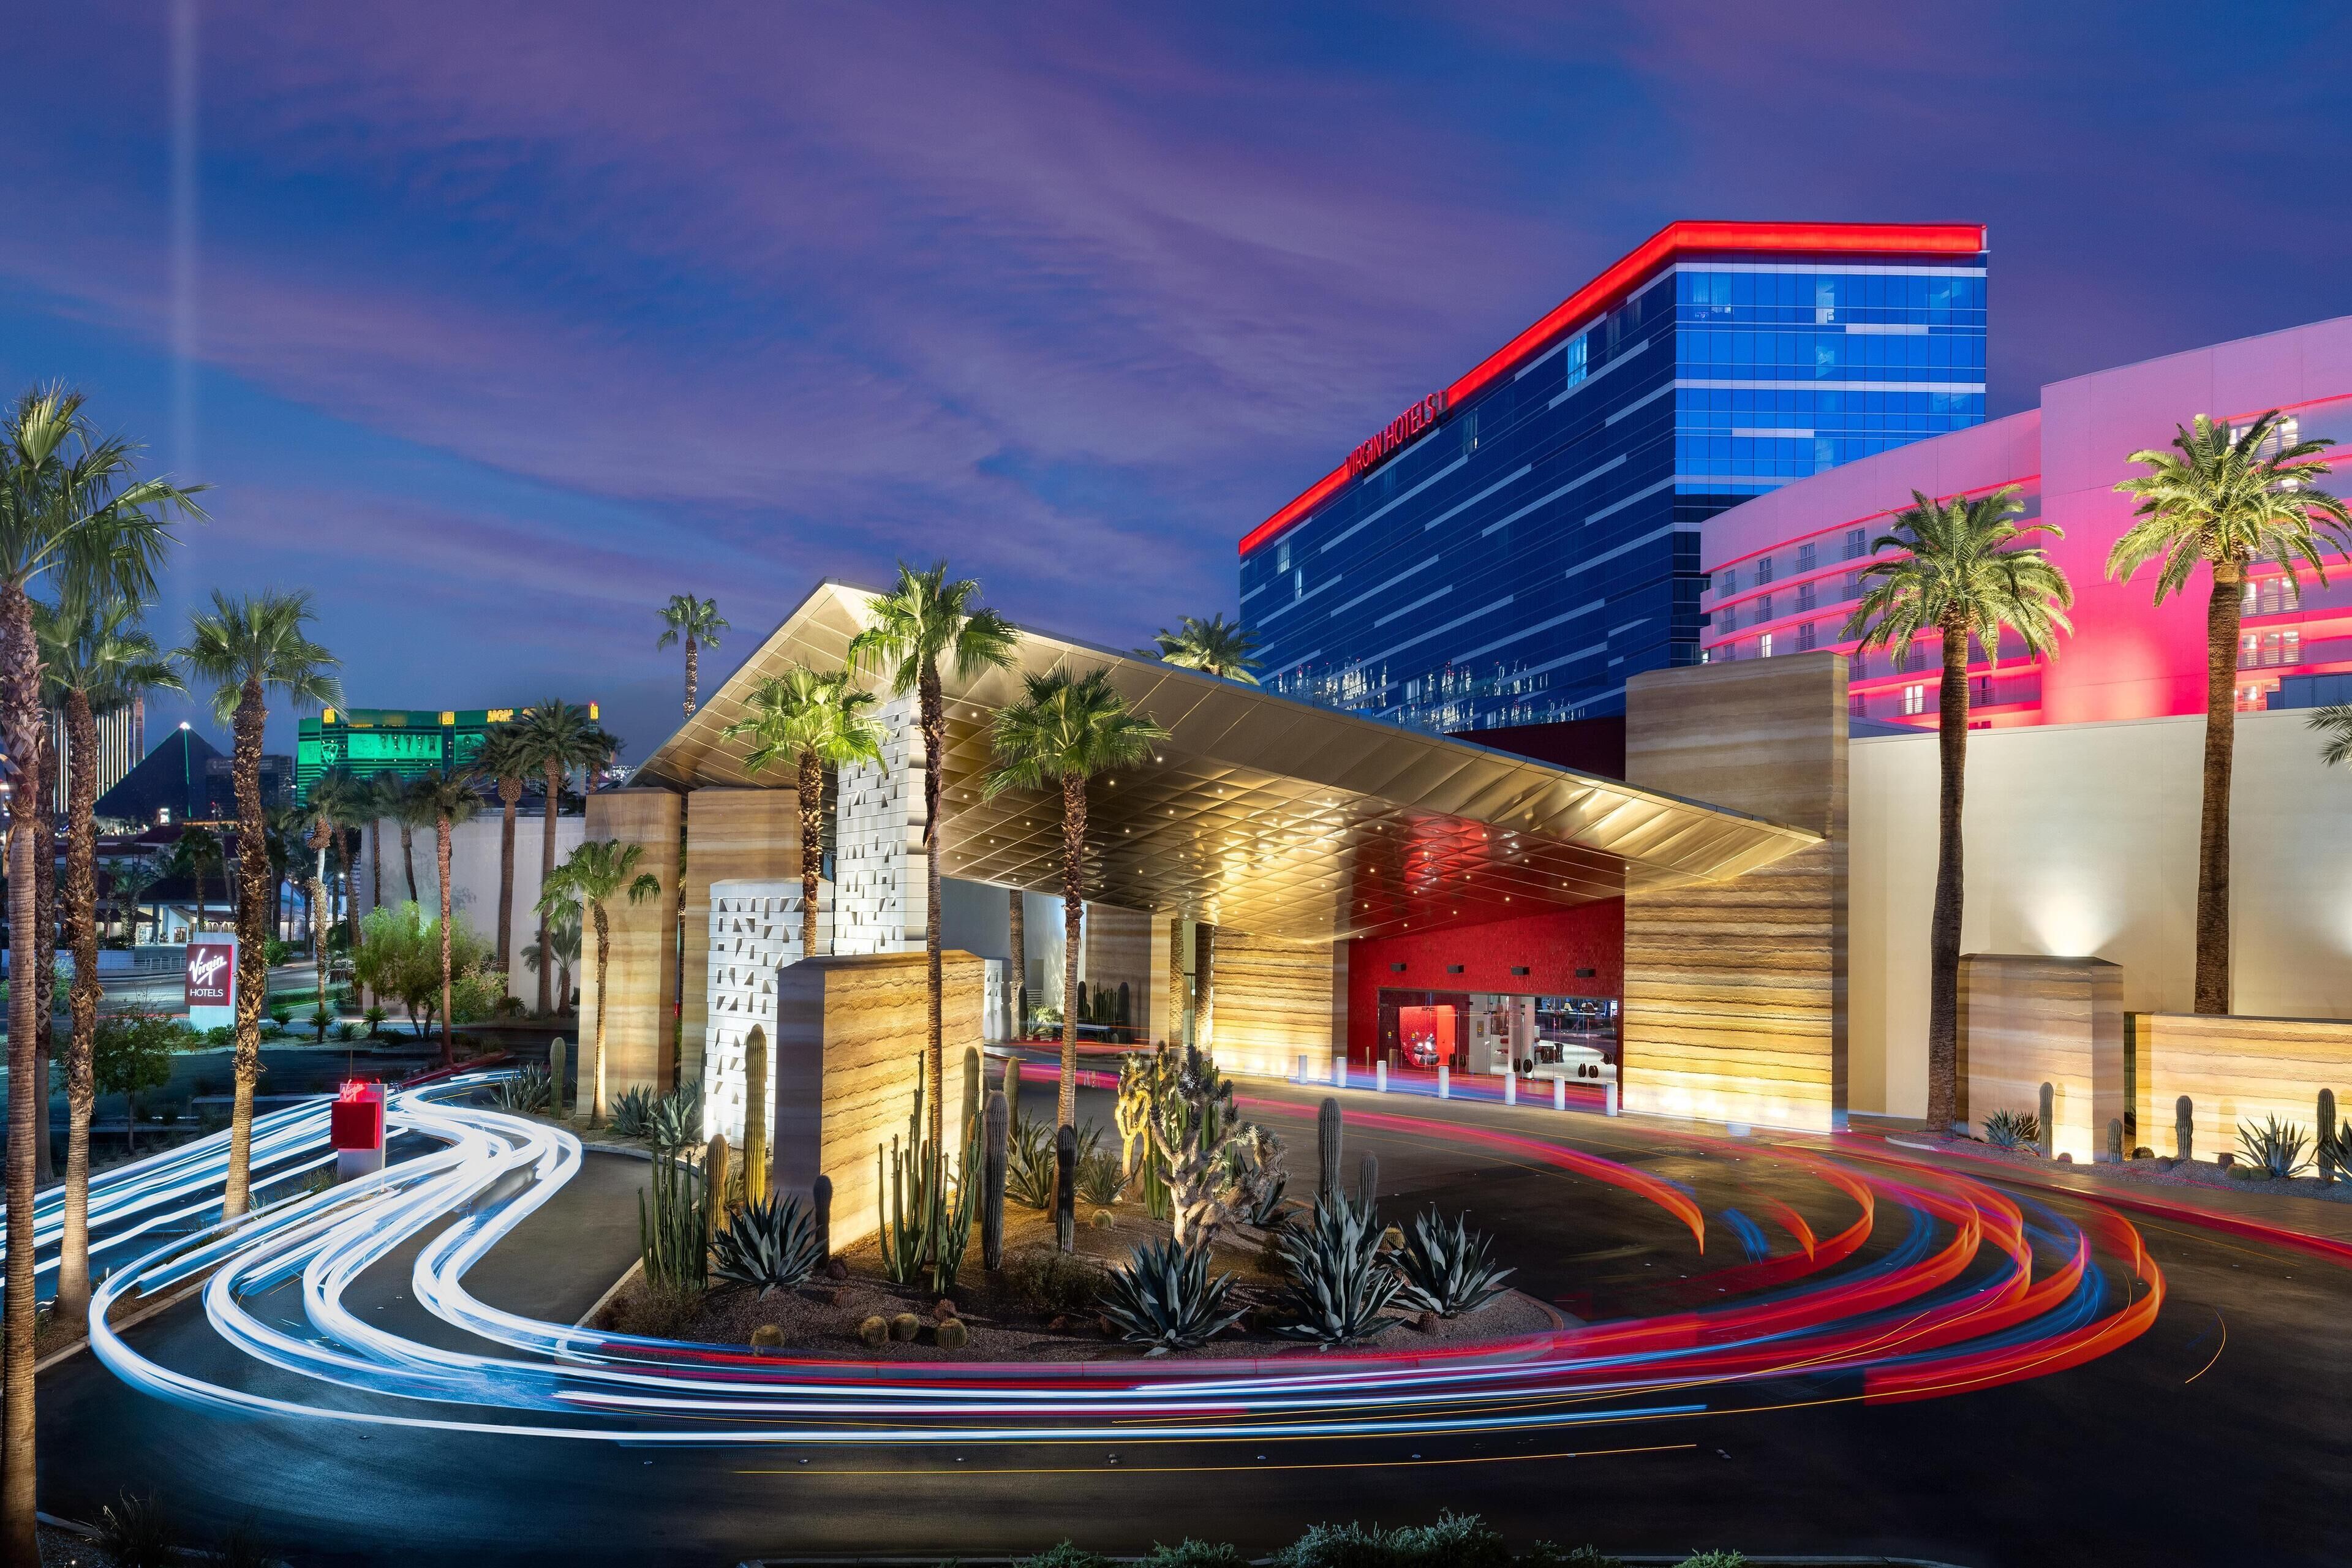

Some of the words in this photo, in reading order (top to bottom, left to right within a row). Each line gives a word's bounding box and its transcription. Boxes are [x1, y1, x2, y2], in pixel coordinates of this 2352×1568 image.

[1345, 431, 1382, 480] VIRGIN
[1385, 394, 1437, 451] HOTELS
[487, 709, 513, 723] MGM
[189, 948, 227, 986] Virgin
[190, 989, 223, 997] HOTELS
[341, 1079, 365, 1102] Virgin
